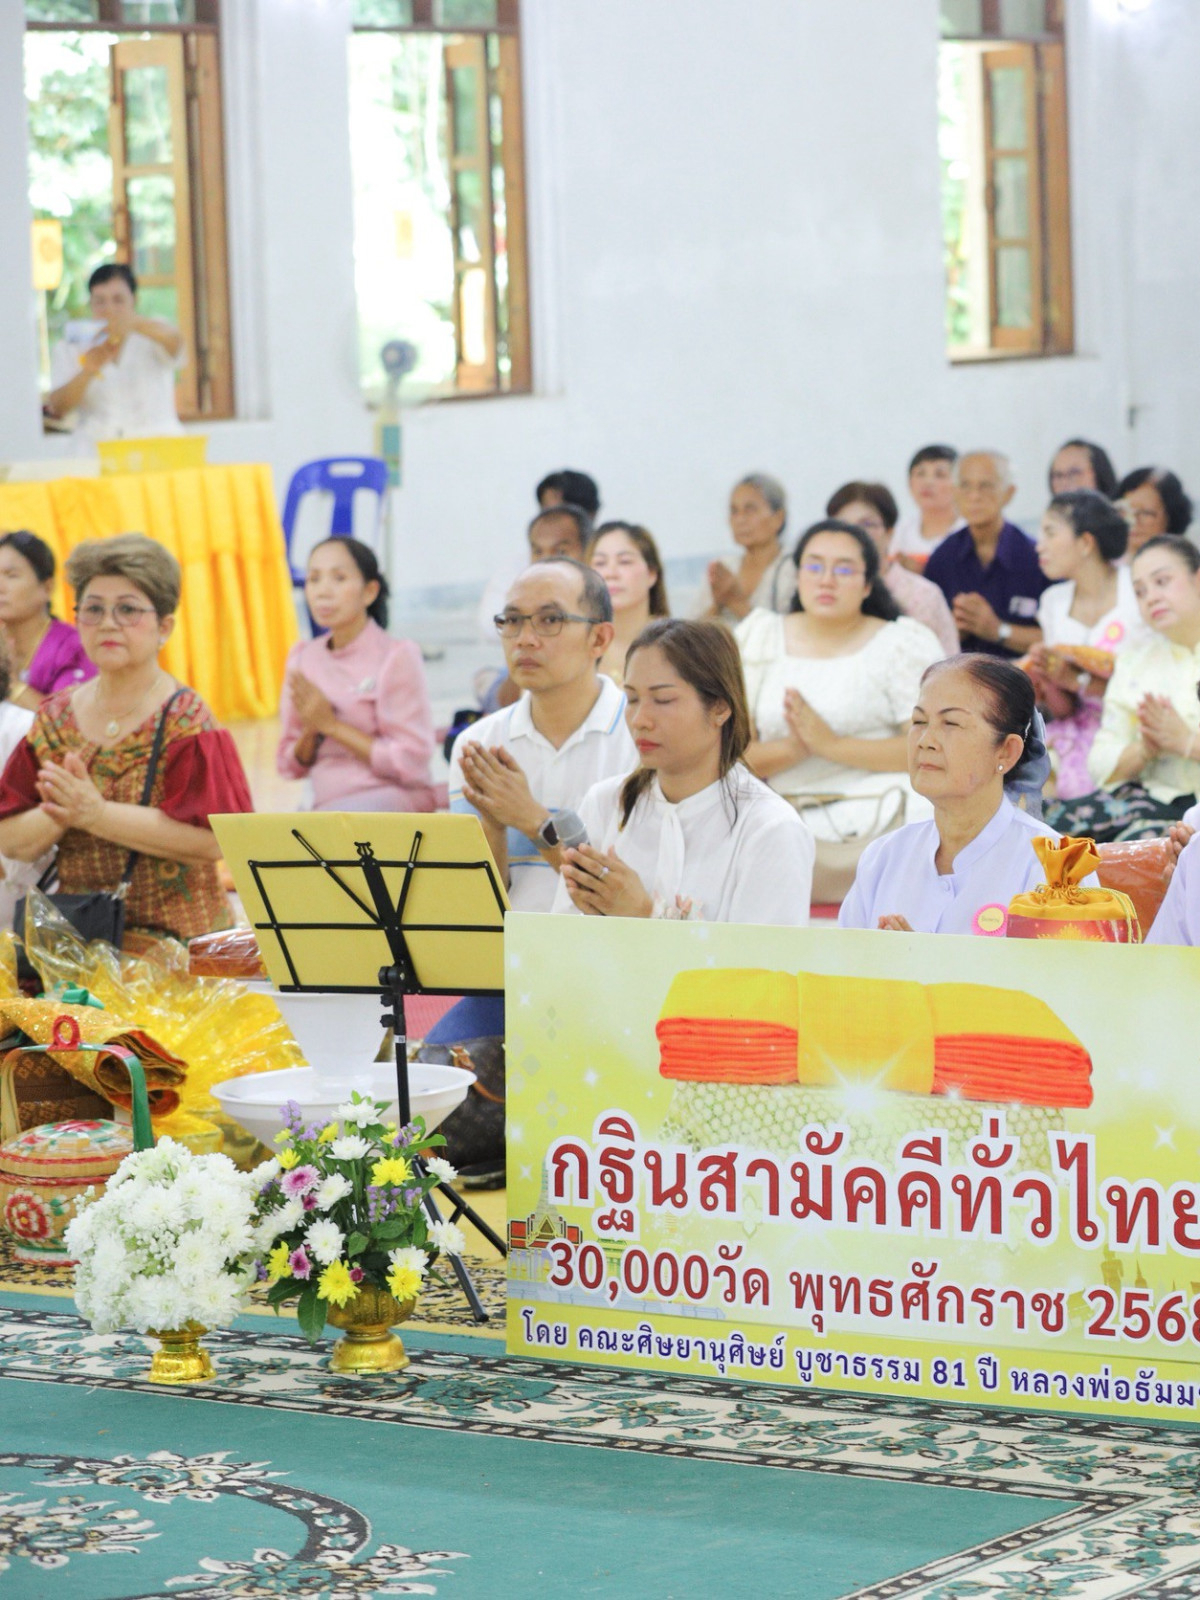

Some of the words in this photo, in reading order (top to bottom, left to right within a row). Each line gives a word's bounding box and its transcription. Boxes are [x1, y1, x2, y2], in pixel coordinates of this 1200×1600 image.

[551, 1243, 770, 1306] 30,000วัด
[789, 1261, 1065, 1333] พุทธศักราช
[522, 1310, 567, 1345] โดย
[579, 1325, 784, 1373] คณะศิษยานุศิษย์
[796, 1348, 920, 1383] บูชาธรรม
[933, 1359, 966, 1387] 81
[977, 1358, 998, 1389] ปี
